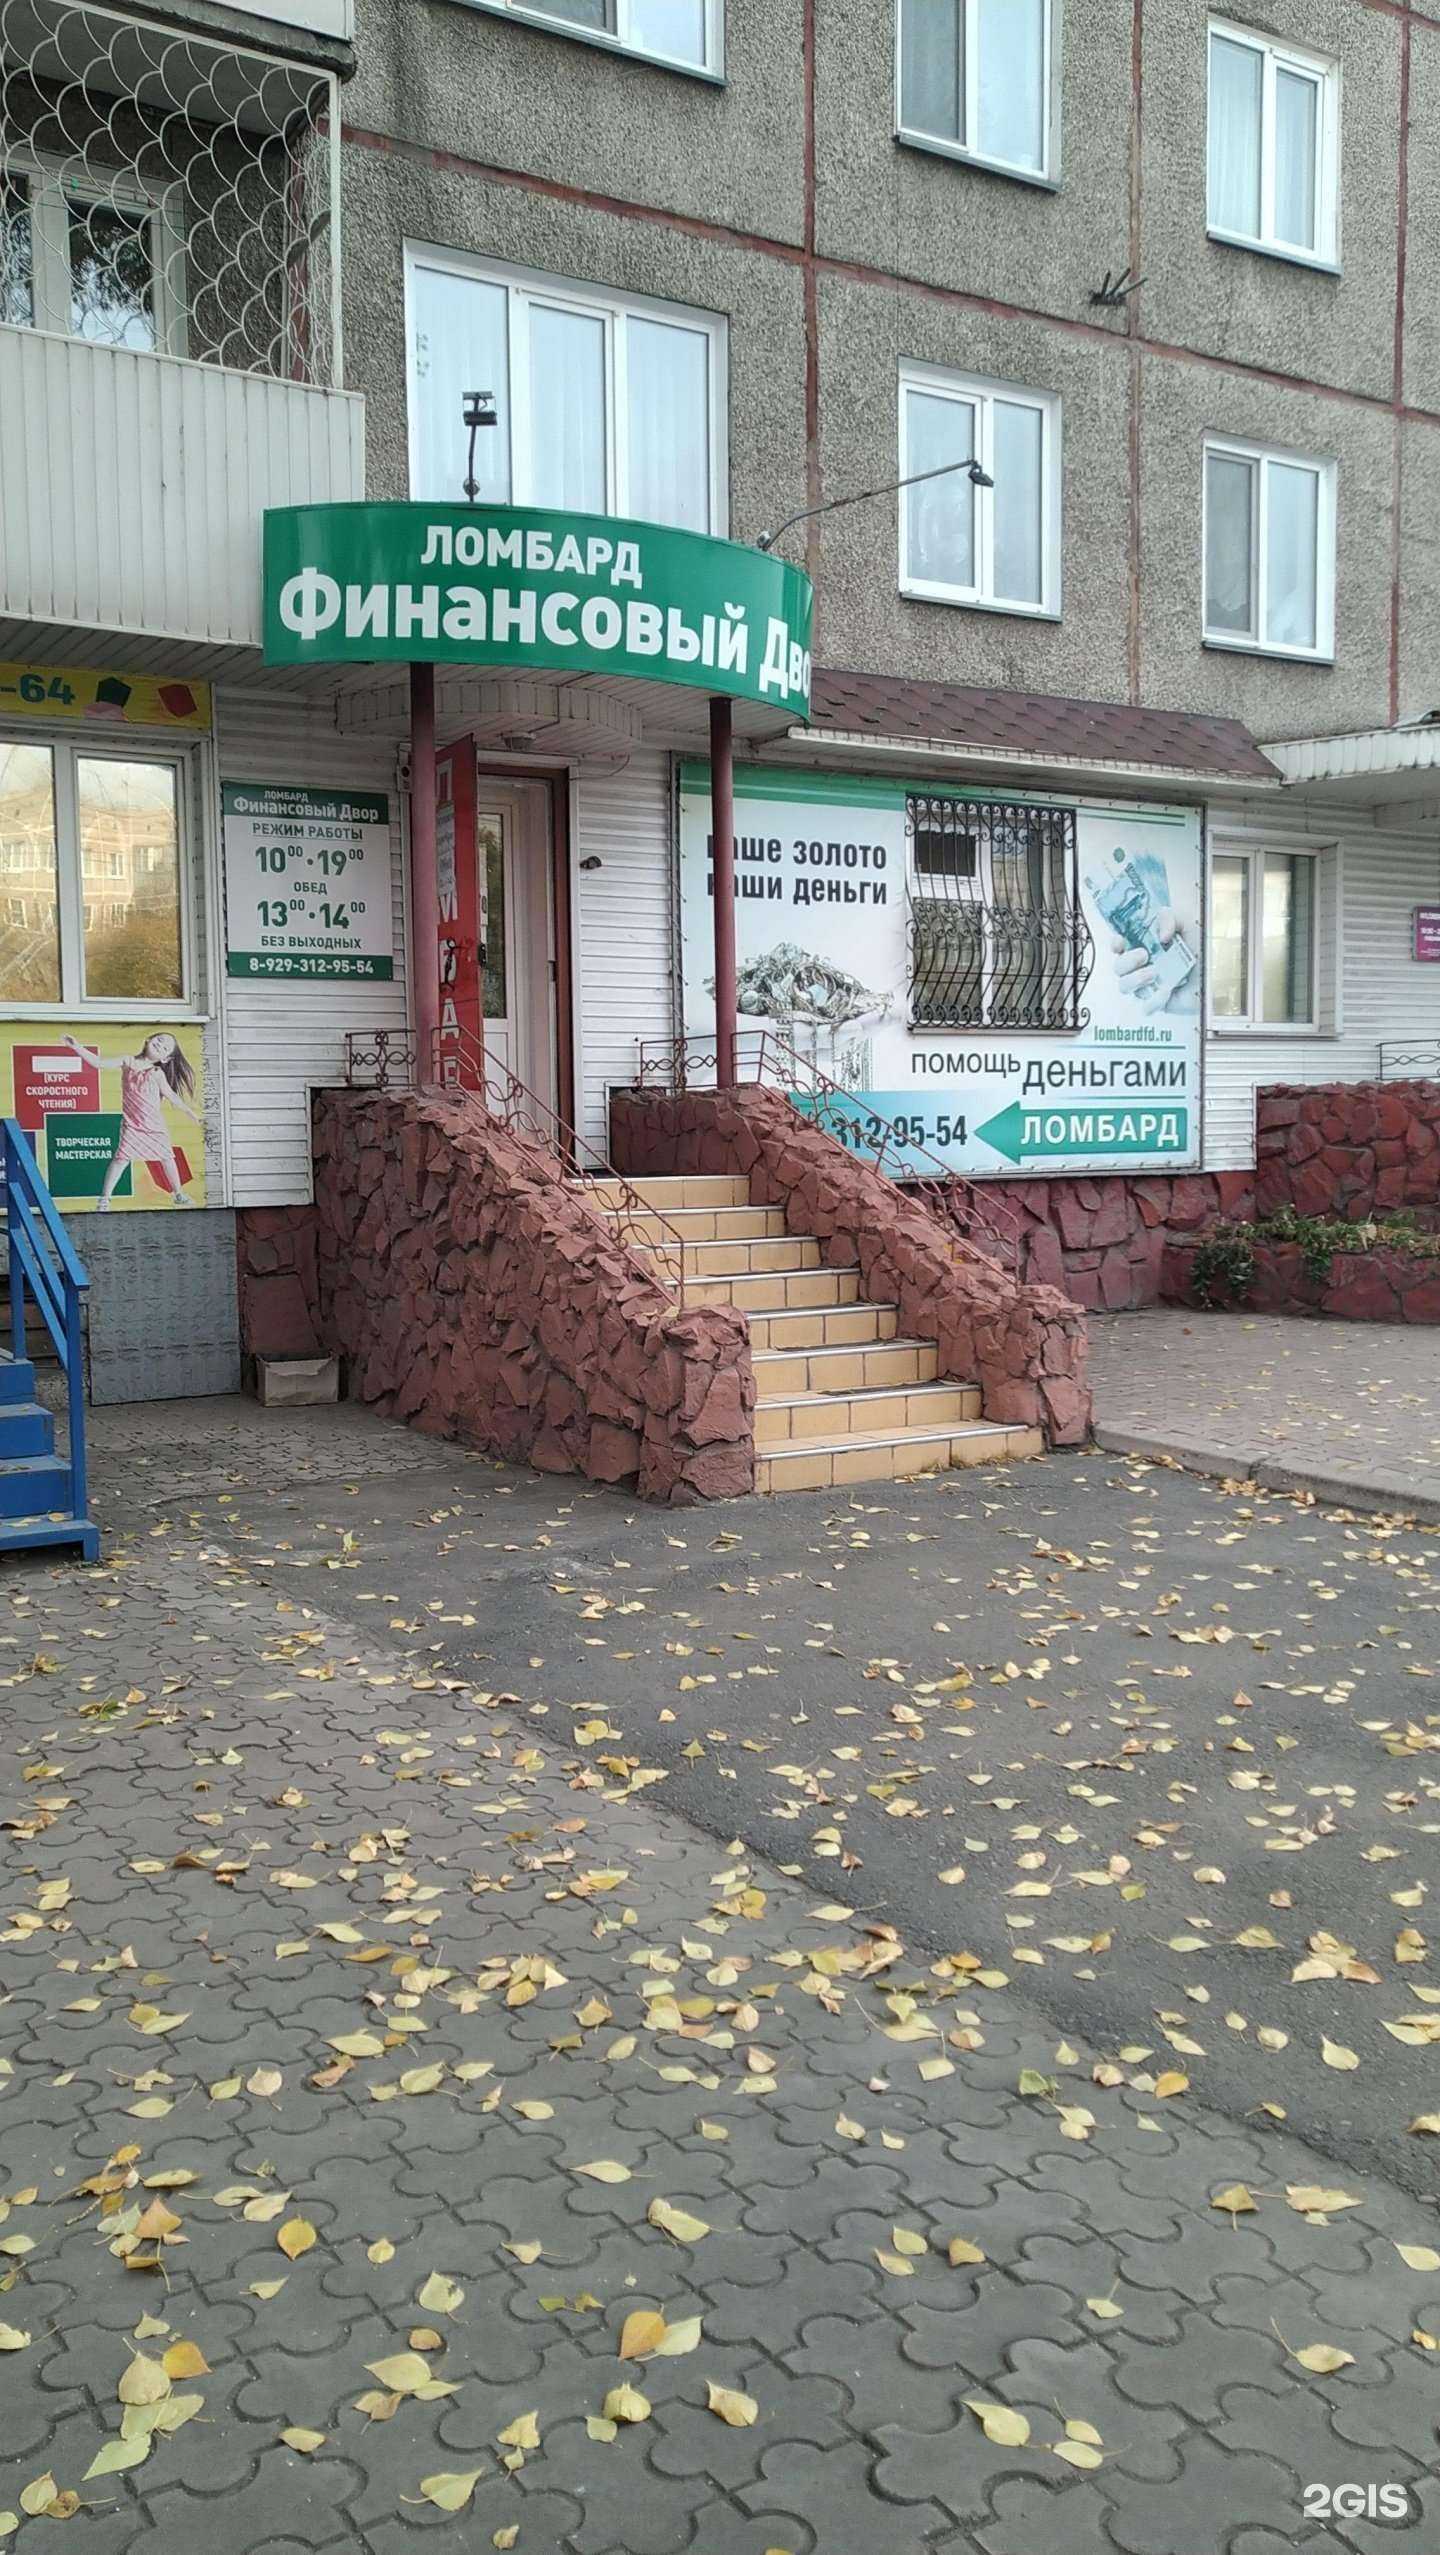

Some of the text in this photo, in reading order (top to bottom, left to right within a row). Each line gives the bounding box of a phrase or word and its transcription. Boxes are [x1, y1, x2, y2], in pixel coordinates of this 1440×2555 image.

[421, 525, 643, 589] ЛОМБАРД
[279, 567, 748, 674] Финансовый
[264, 790, 309, 803] ЛОМБАРД
[233, 796, 379, 823] Финансовый Двор
[252, 823, 363, 840] РЕЖИМ РАБОТЫ
[793, 840, 887, 869] золото
[294, 881, 328, 895] ОБЕД
[793, 878, 887, 906] деньги
[261, 935, 362, 950] БЕЗ ВЫХОДНЫХ
[249, 957, 374, 974] 8-929-312-95-54
[1094, 1026, 1172, 1041] lombardfd.ru
[912, 1053, 1186, 1095] помощь деньгами
[25, 1086, 89, 1096] СКОРОСТНОГО
[1021, 1114, 1179, 1147] ЛОМБАРД
[55, 1137, 111, 1147] ТВОРЧЕСКАЯ
[55, 1150, 112, 1160] МАСТЕРСКАЯ
